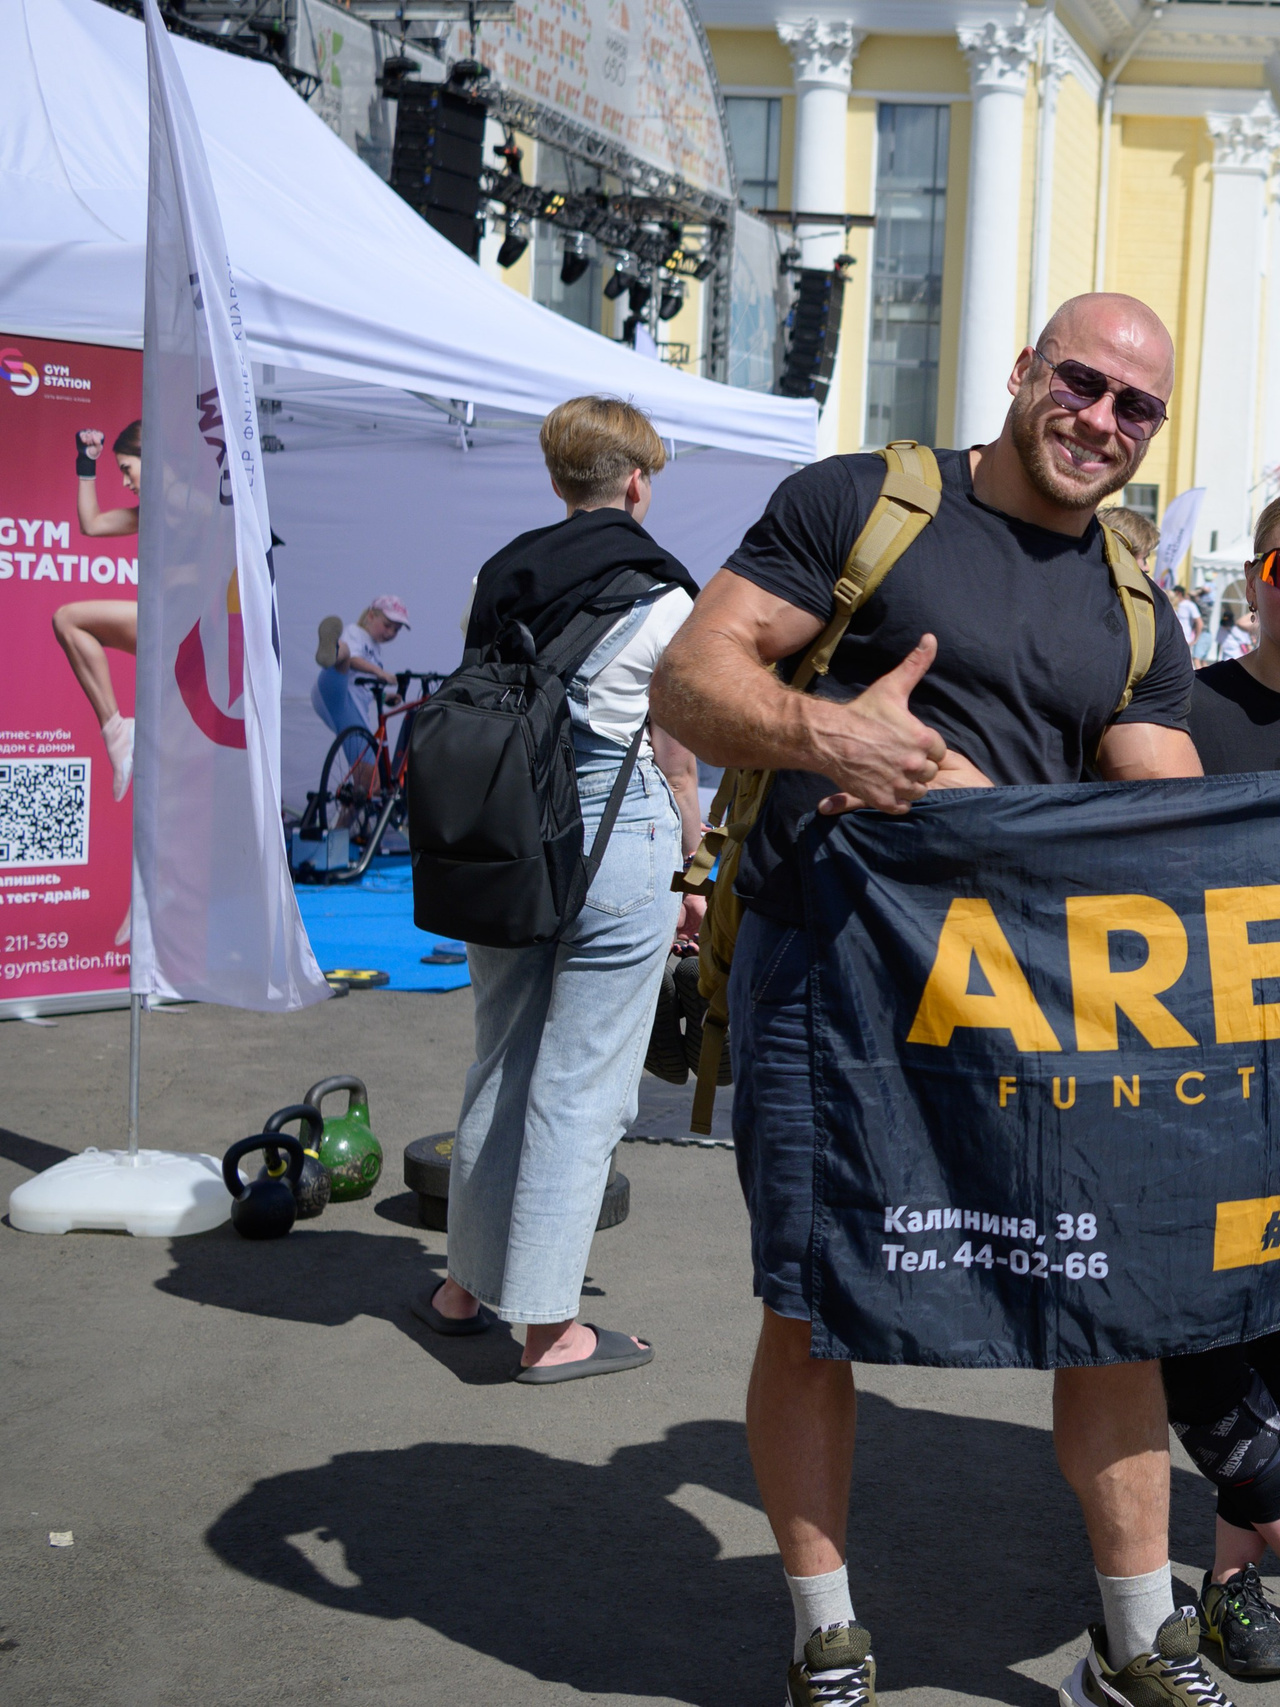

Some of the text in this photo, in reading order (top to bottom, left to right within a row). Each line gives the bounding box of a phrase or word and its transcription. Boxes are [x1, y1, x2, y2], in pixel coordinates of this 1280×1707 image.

[43, 363, 70, 377] GYM
[43, 375, 91, 390] STATION
[0, 517, 70, 549] GYM
[0, 551, 139, 585] STATION
[0, 730, 71, 741] итнес-клубы
[28, 744, 36, 753] с
[37, 743, 75, 754] домом
[0, 874, 61, 887] апишись
[6, 886, 90, 904] тест-драйв
[5, 931, 69, 953] 211-369
[4, 951, 131, 979] gymstation.fitn
[884, 1205, 1098, 1246] Калинина, 38
[882, 1240, 1109, 1280] Тел. 44-02-66
[1217, 1439, 1253, 1478] ROCKTAPE
